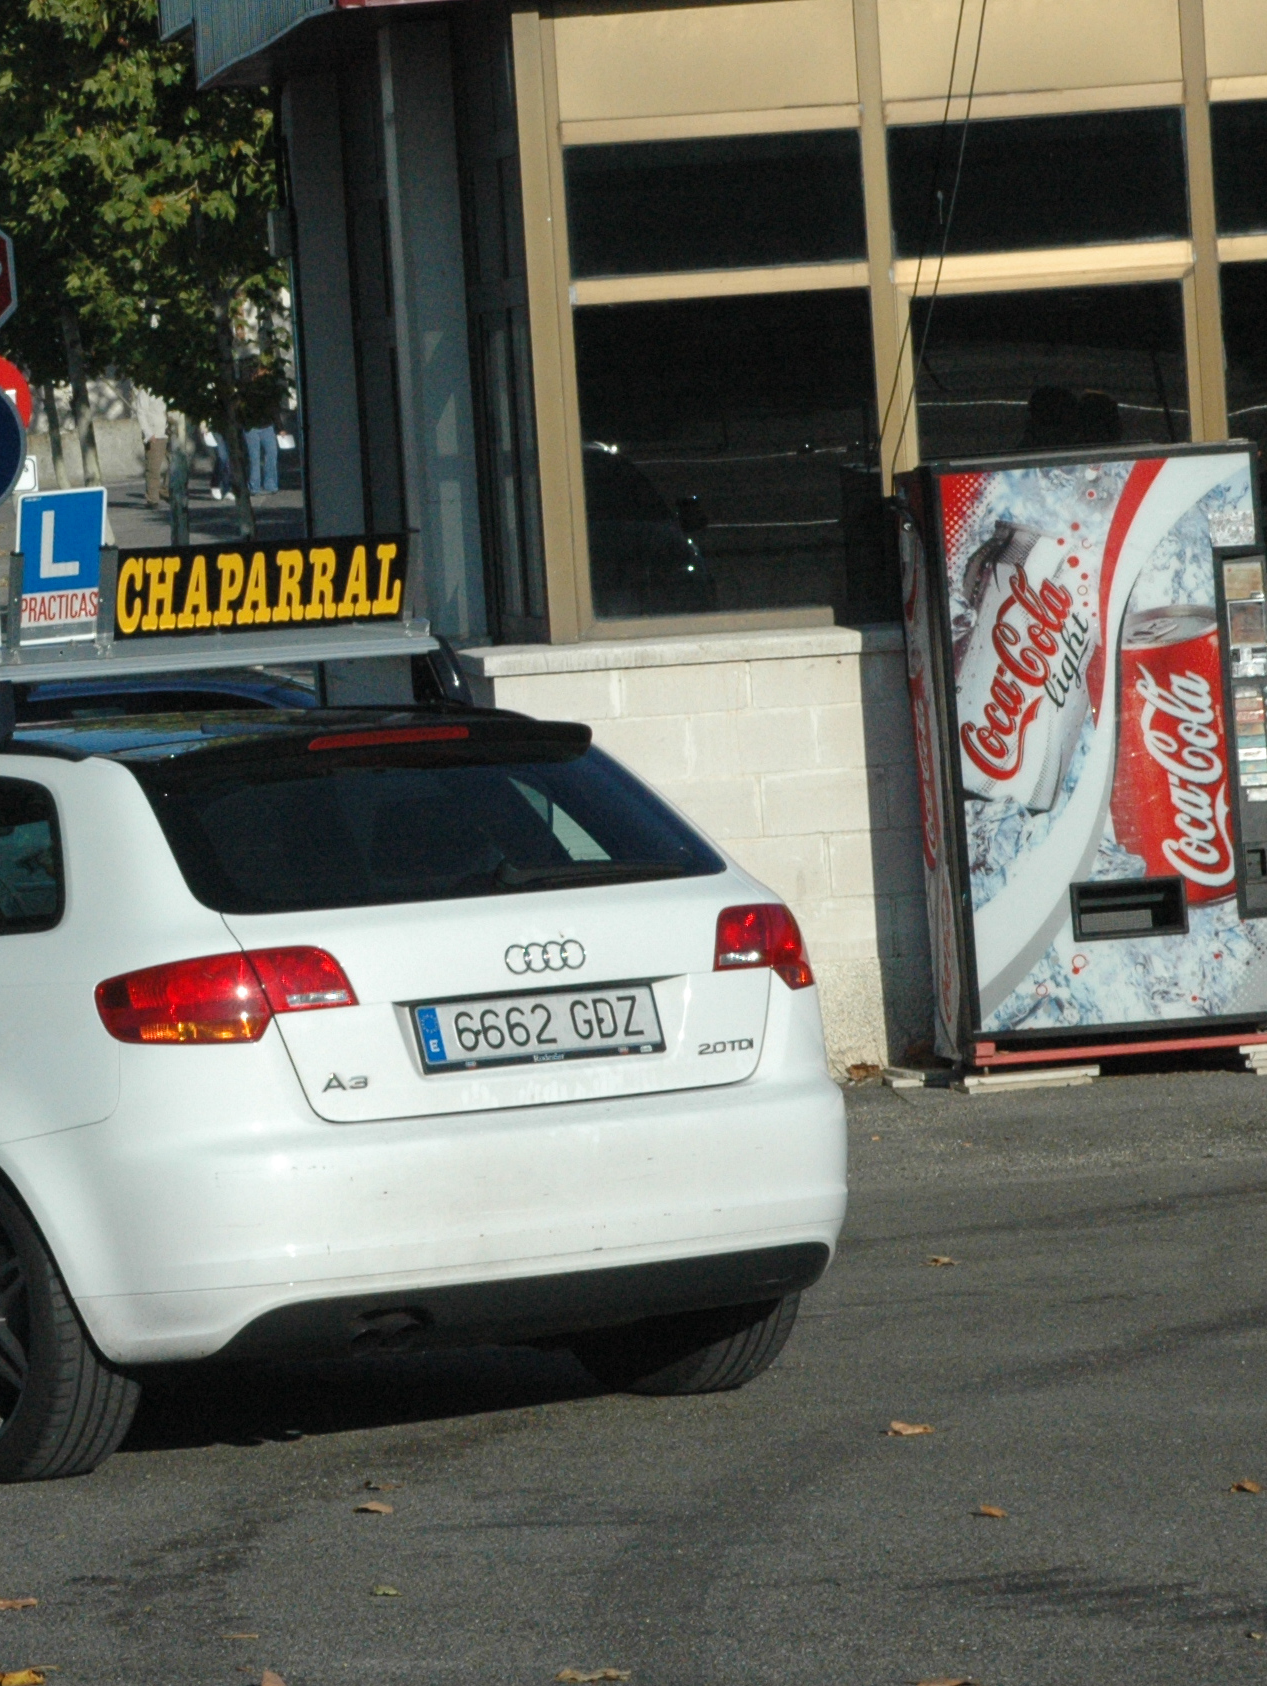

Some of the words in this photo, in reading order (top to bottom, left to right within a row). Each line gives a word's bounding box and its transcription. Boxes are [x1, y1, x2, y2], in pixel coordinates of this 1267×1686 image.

[40, 510, 80, 579] L
[20, 591, 99, 623] PRACTICAS
[116, 543, 401, 634] CHAPARRAL
[960, 562, 1074, 781] Coca-Cola
[1044, 611, 1091, 713] light
[1136, 661, 1236, 887] Coca-Cola
[454, 1003, 558, 1053] 6662
[570, 994, 645, 1041] GDZ
[322, 1071, 369, 1093] A3
